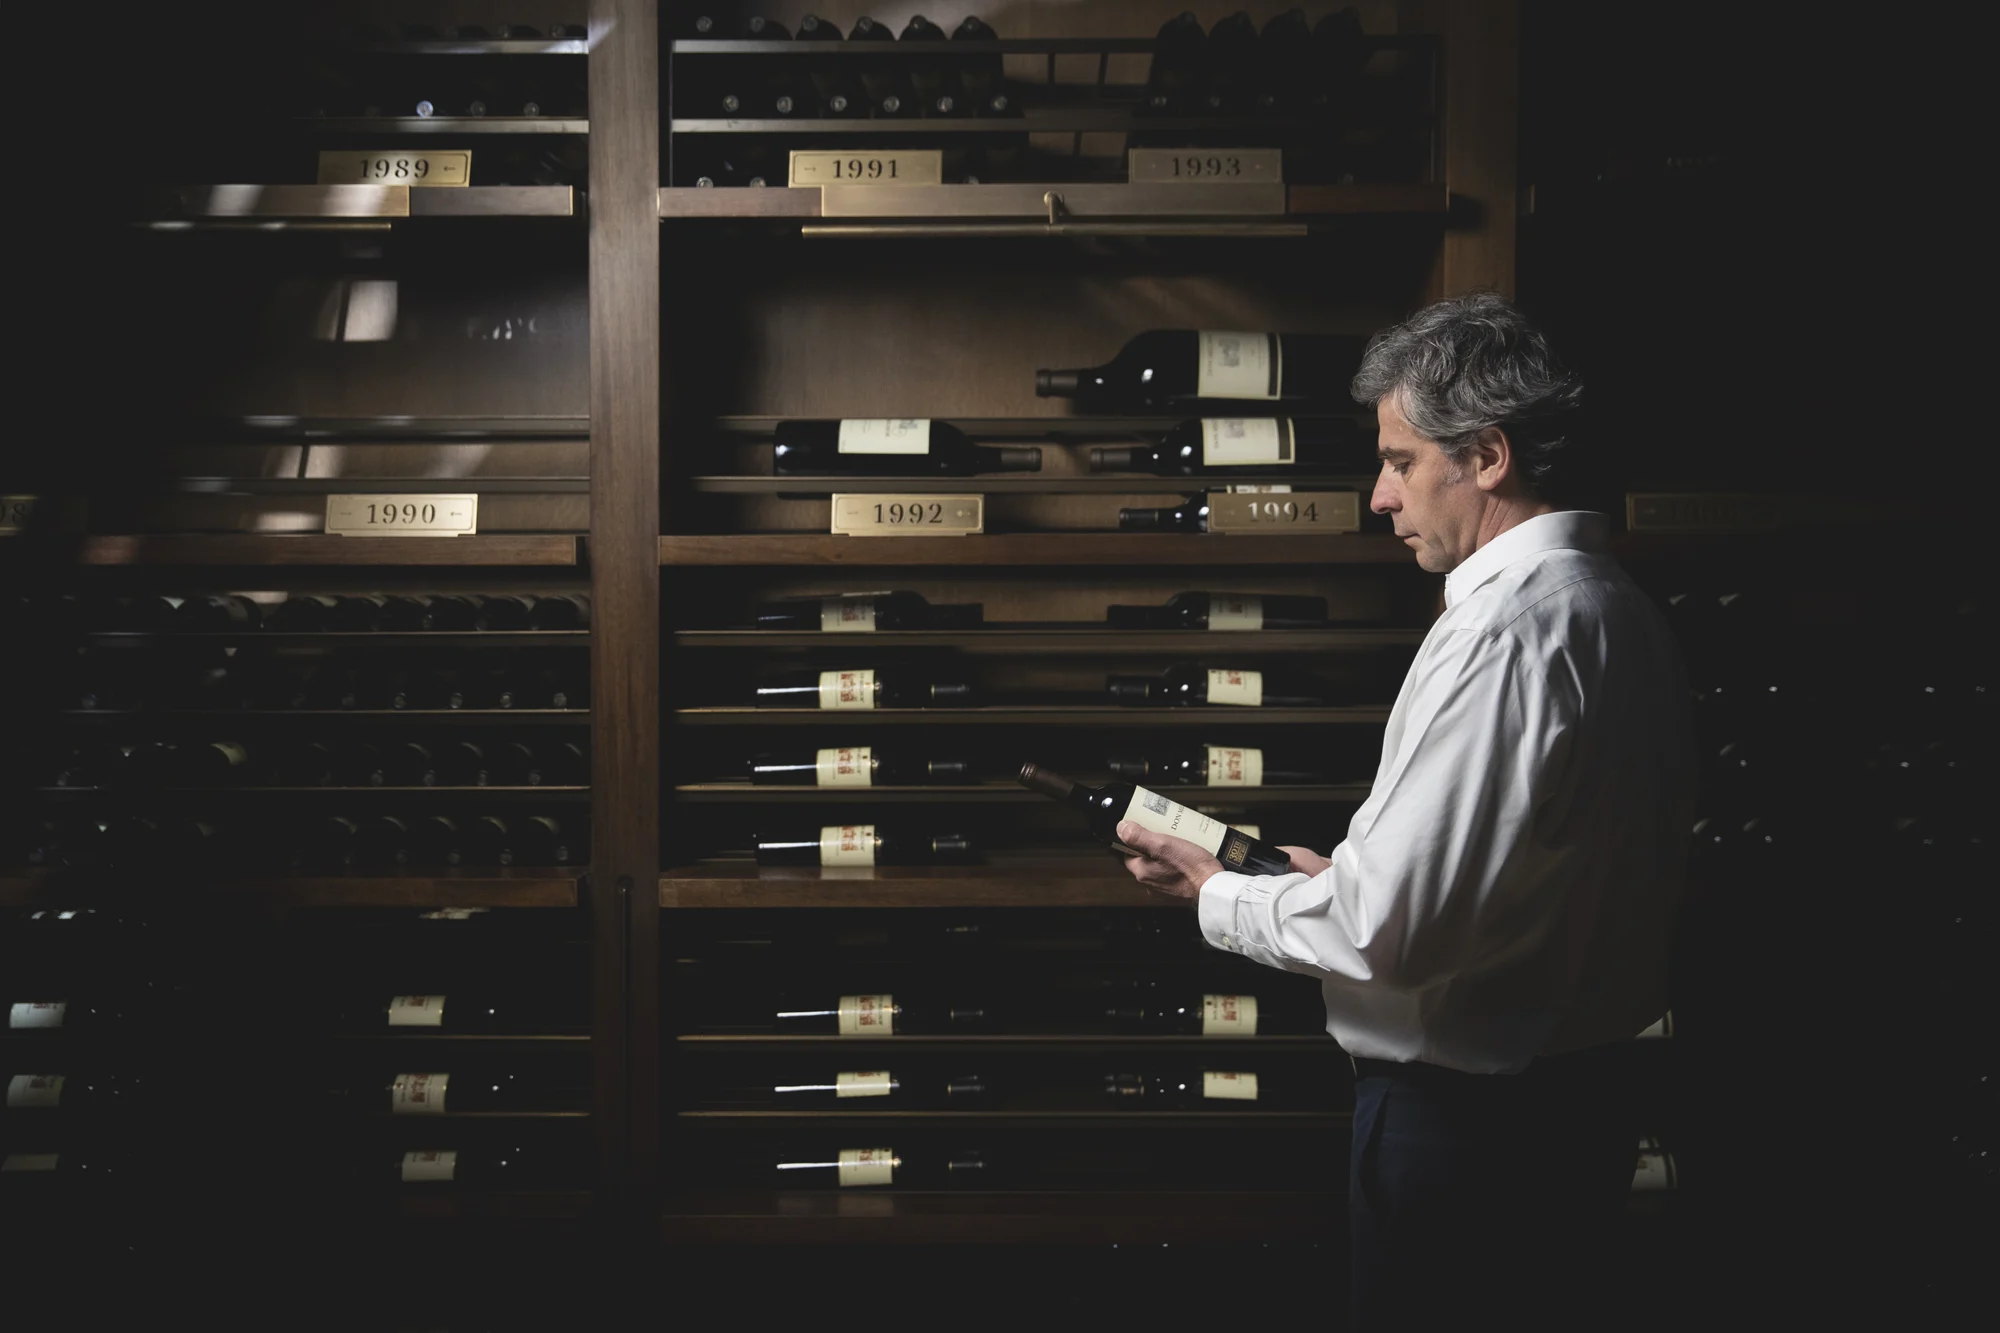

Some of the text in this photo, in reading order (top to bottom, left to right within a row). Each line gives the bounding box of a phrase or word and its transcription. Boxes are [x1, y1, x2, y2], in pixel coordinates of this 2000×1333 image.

[360, 158, 430, 179] 1989
[832, 158, 900, 180] 1991
[1171, 156, 1241, 177] 1993
[366, 503, 437, 525] 1990
[873, 502, 944, 525] 1992
[1247, 501, 1319, 523] 1994
[1170, 812, 1182, 831] DON
